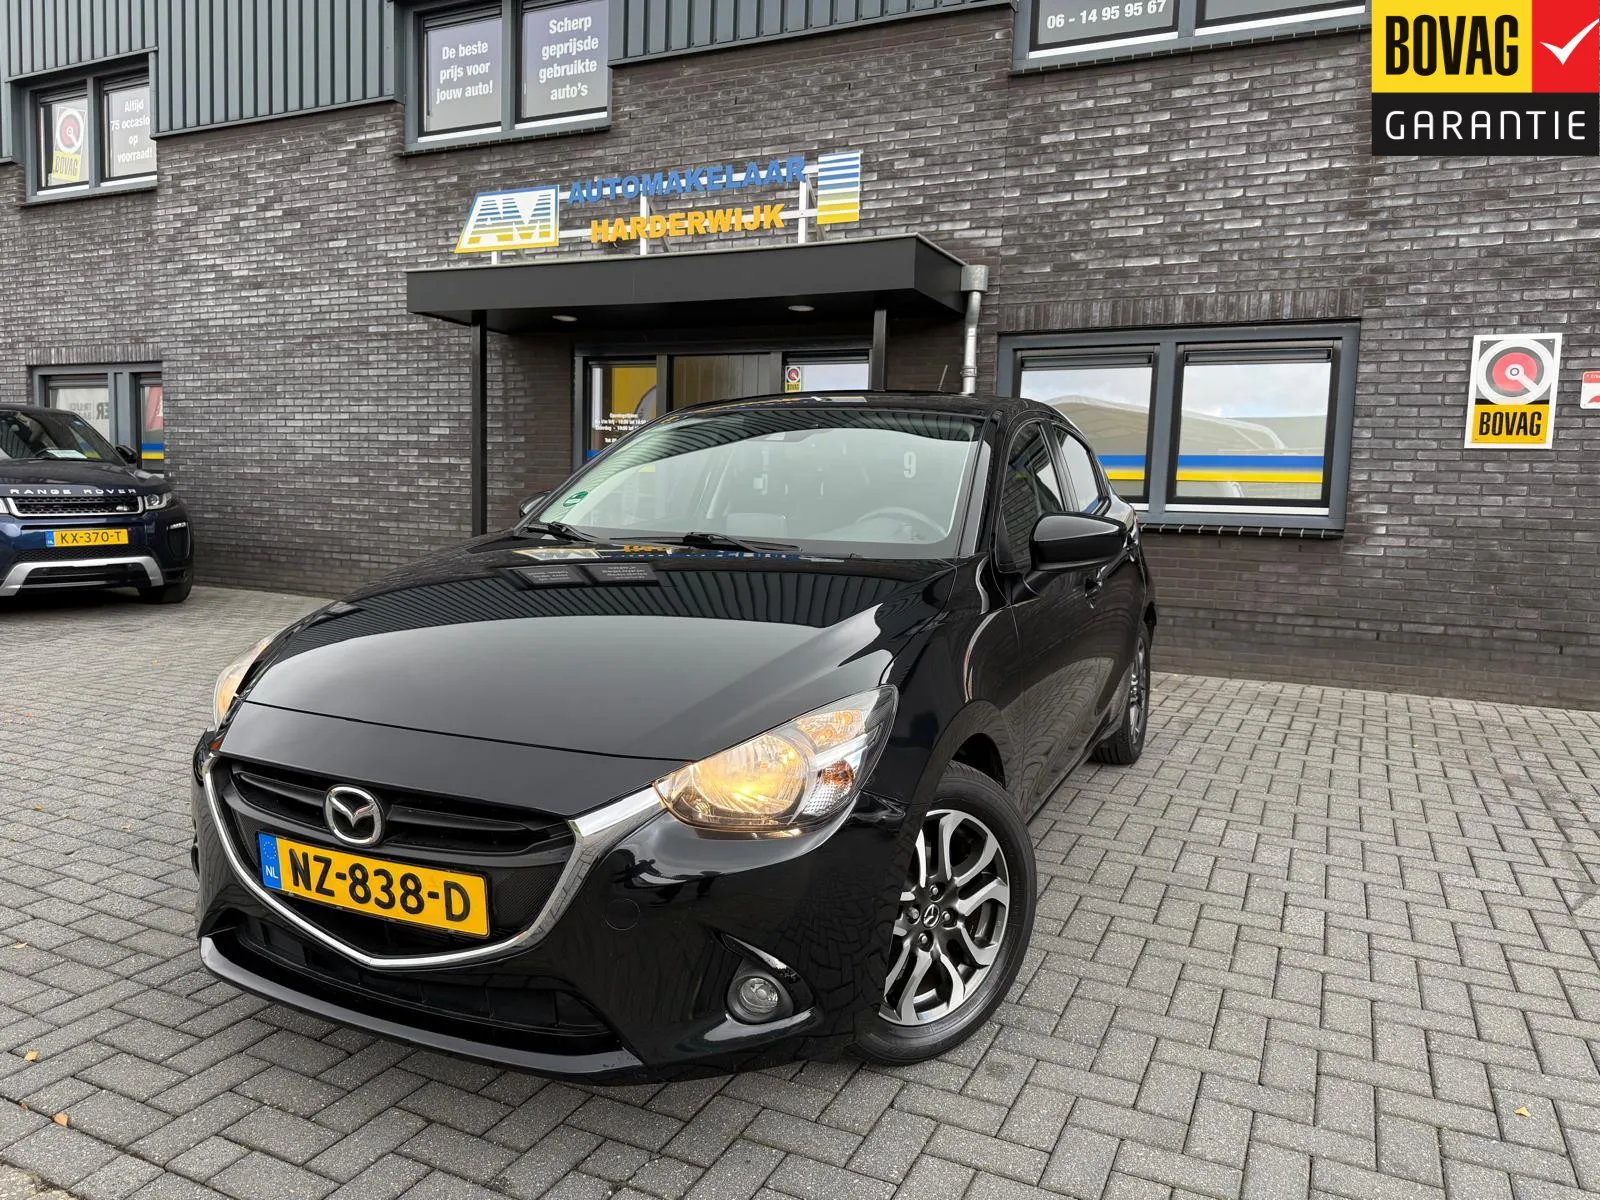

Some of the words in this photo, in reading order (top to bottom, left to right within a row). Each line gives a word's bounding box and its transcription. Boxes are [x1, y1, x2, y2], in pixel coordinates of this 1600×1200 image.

[549, 16, 592, 34] Scherp
[1046, 14, 1065, 29] 06
[1080, 8, 1098, 24] 14
[1101, 5, 1120, 21] 95
[1124, 2, 1143, 18] 95
[1147, 0, 1167, 14] 67
[442, 46, 457, 60] De
[458, 40, 489, 57] beste
[541, 36, 599, 60] geprijsde
[439, 64, 464, 84] prijs
[466, 61, 491, 76] voor
[538, 59, 598, 84] gebruikte
[436, 86, 463, 104] jouw
[464, 80, 494, 98] auto!
[550, 81, 589, 101] auto's
[124, 99, 145, 112] Altijd
[111, 120, 121, 131] 75
[121, 115, 150, 129] occasio
[128, 134, 138, 146] op
[55, 155, 78, 176] BOVAG
[117, 149, 153, 163] voorraad!
[568, 155, 807, 204] AUTOMAKELAAR
[590, 203, 785, 244] HARDERWIJK
[1478, 411, 1543, 436] BOVAG
[60, 531, 121, 545] KX-370-T
[265, 864, 279, 880] NL
[288, 847, 472, 922] NZ-838-D
